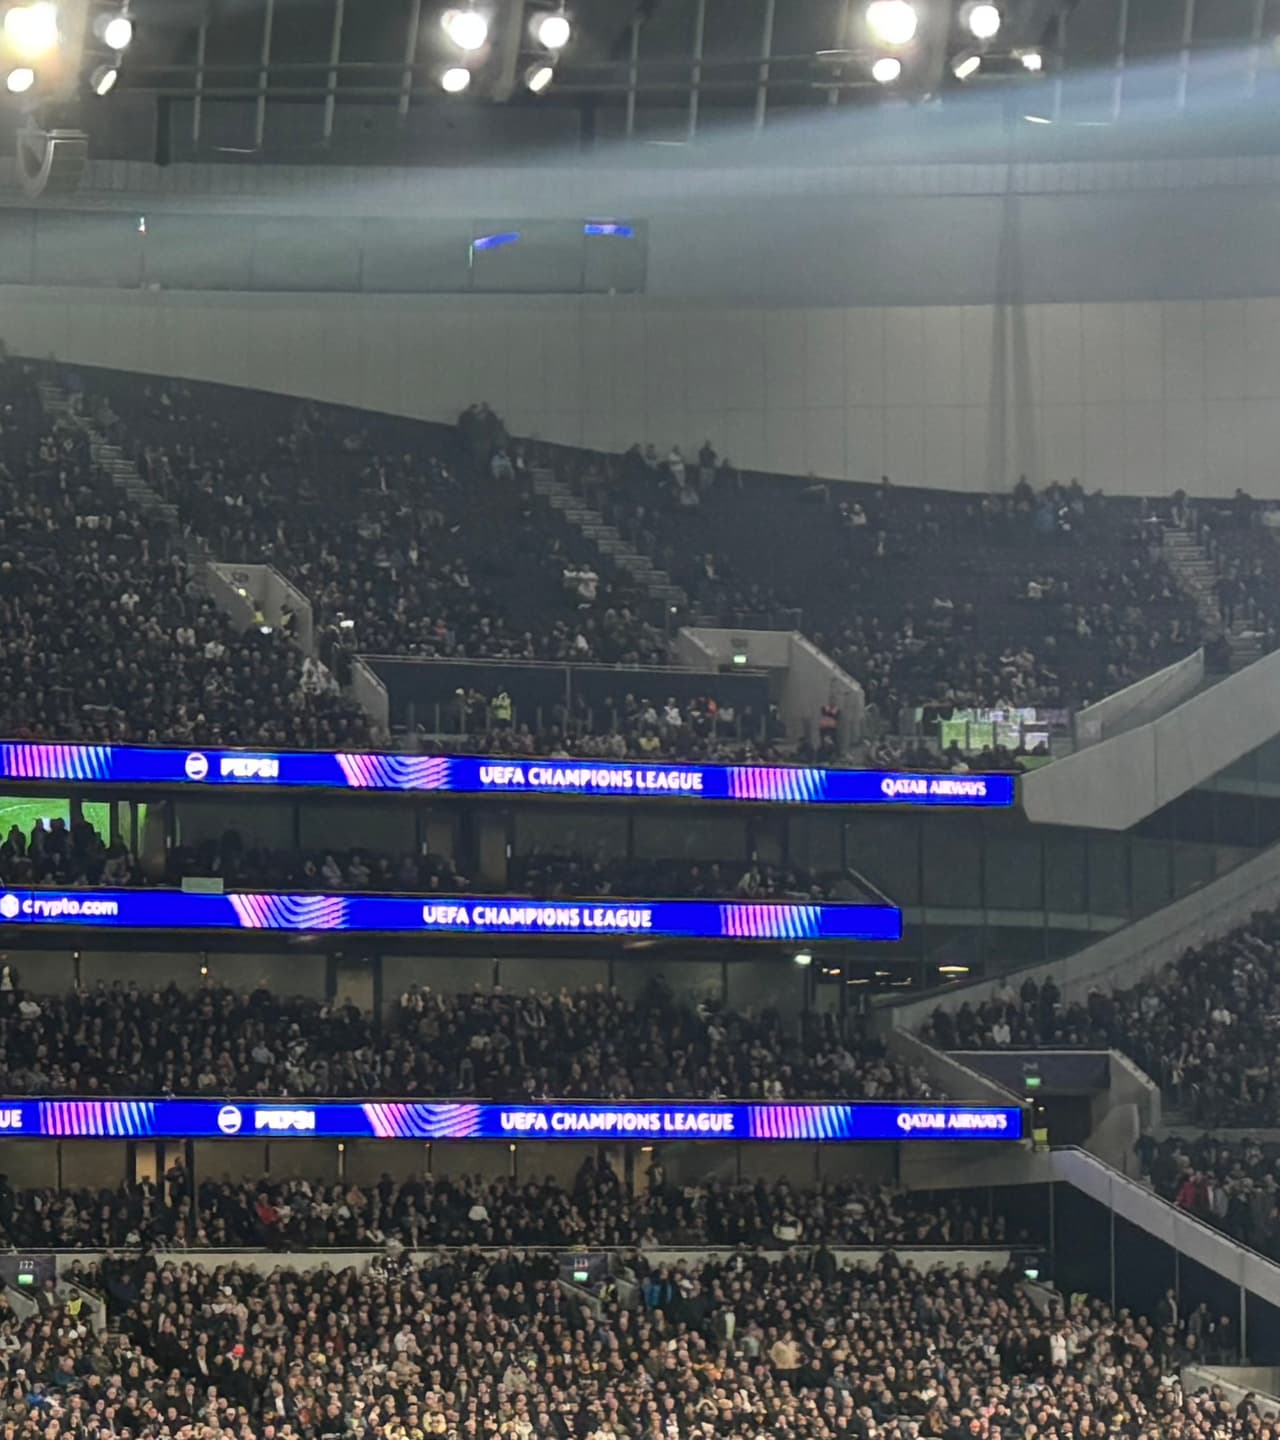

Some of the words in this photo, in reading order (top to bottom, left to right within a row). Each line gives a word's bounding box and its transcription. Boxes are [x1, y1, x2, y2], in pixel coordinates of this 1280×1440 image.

[480, 766, 525, 785] UEFA
[528, 767, 632, 790] CHAMPIONS
[635, 771, 703, 792] LEAGUE
[881, 778, 927, 796] QATAR
[930, 780, 986, 796] AIRWAYS
[22, 898, 119, 917] crypto.com
[423, 905, 469, 924] UEFA
[472, 906, 580, 928] CHAMPIONS
[583, 908, 652, 930] LEAGUE
[501, 1112, 548, 1130] UEFA
[551, 1112, 661, 1131] CHAMPIONS
[664, 1113, 734, 1132] LEAGUE
[897, 1113, 944, 1131] QATAR
[948, 1114, 1007, 1131] AIRWAYS
